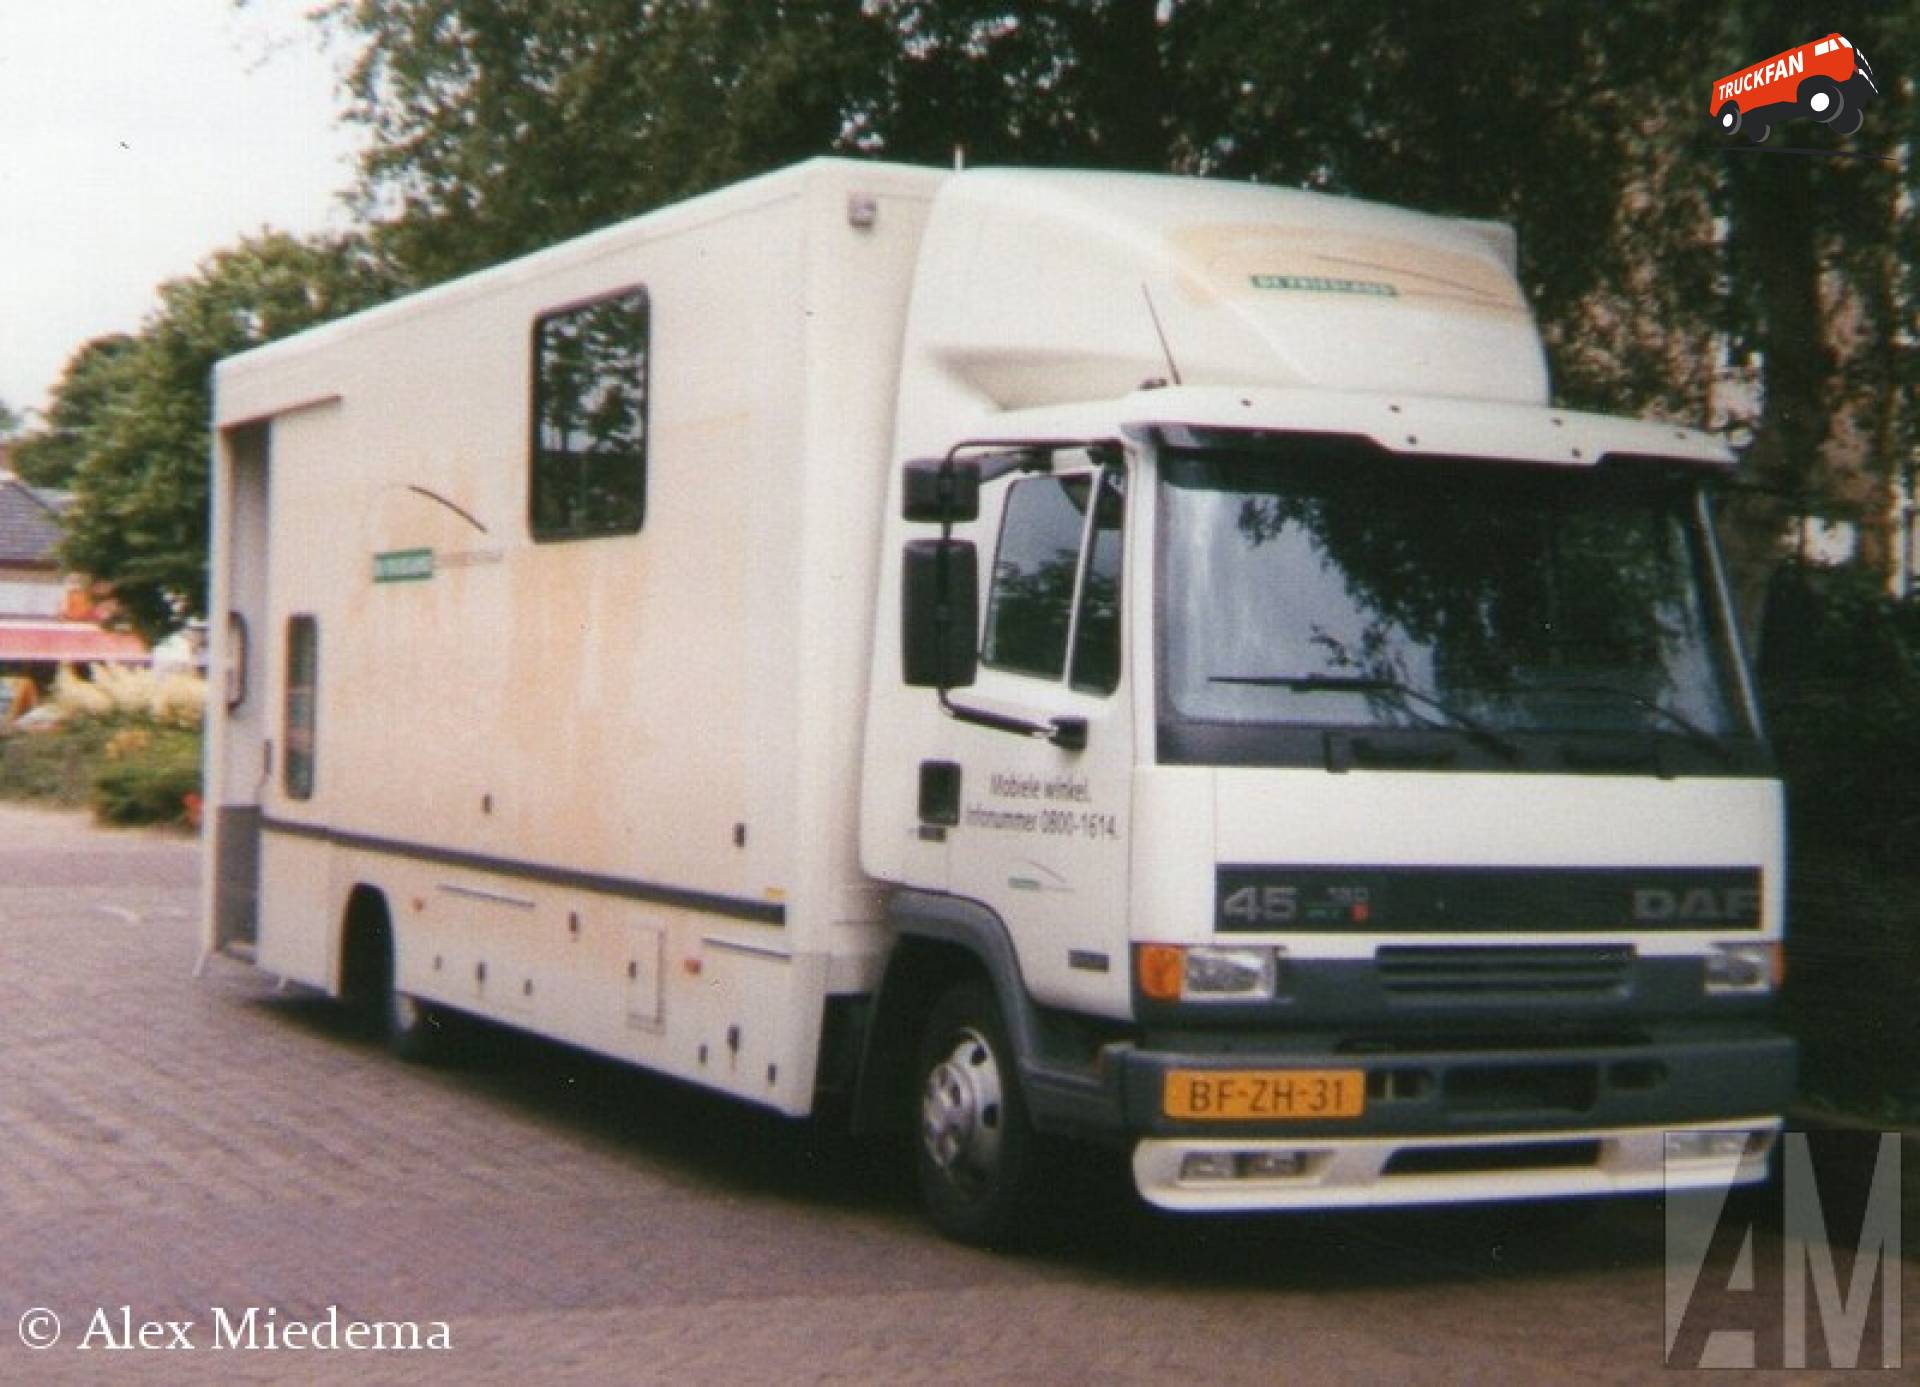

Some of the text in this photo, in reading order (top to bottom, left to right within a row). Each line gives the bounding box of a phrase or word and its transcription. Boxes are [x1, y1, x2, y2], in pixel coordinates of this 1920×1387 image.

[991, 774, 1039, 799] Mobiele
[1224, 887, 1297, 922] 45
[1633, 889, 1761, 920] DAF
[1190, 1079, 1345, 1113] BF-ZH-31
